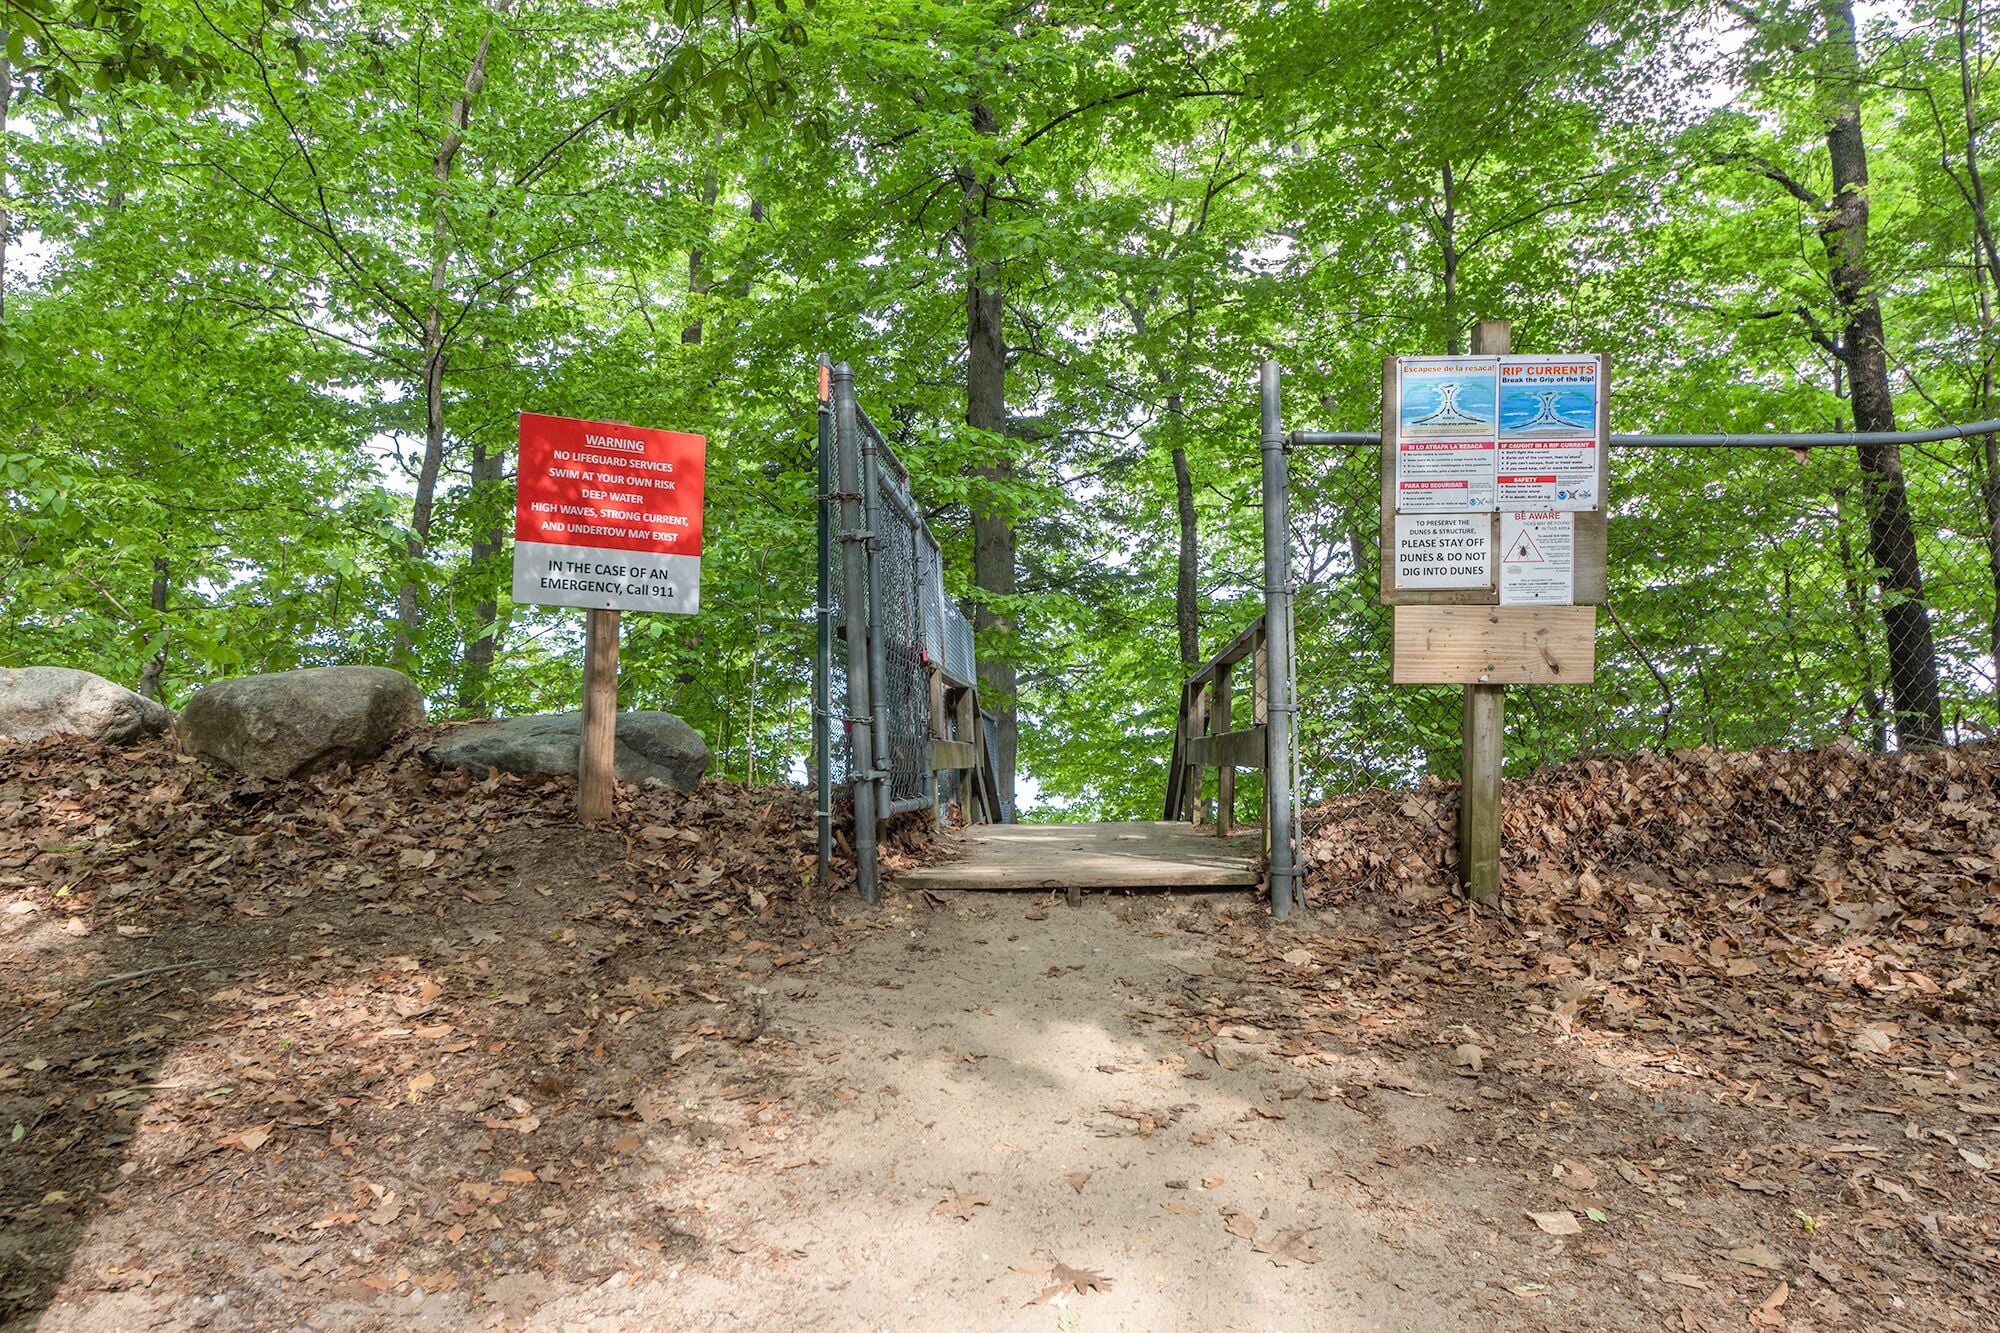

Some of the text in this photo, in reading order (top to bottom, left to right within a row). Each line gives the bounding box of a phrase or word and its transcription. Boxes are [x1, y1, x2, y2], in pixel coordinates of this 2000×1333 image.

[1503, 366, 1594, 375] RIP CURRENTS
[586, 434, 644, 452] WARNING
[554, 450, 673, 472] NO LIFEGUARD SERVICES
[549, 468, 675, 490] SWIM AT YOUR OWN RISK
[582, 489, 643, 504] DEEP WATER
[531, 502, 688, 527] HIGH WAVES, STRONG CURRENT,
[541, 521, 678, 542] AND UNDERTOW MAY EXIST
[1402, 538, 1485, 548] PLEASE STAY OFF
[1400, 553, 1434, 562] DUNES
[1465, 552, 1486, 560] NOT
[548, 560, 668, 580] IN THE CASE OF AN
[1403, 567, 1484, 576] DIG INTO DUNES
[541, 577, 674, 597] EMERGENCY, Call 911
